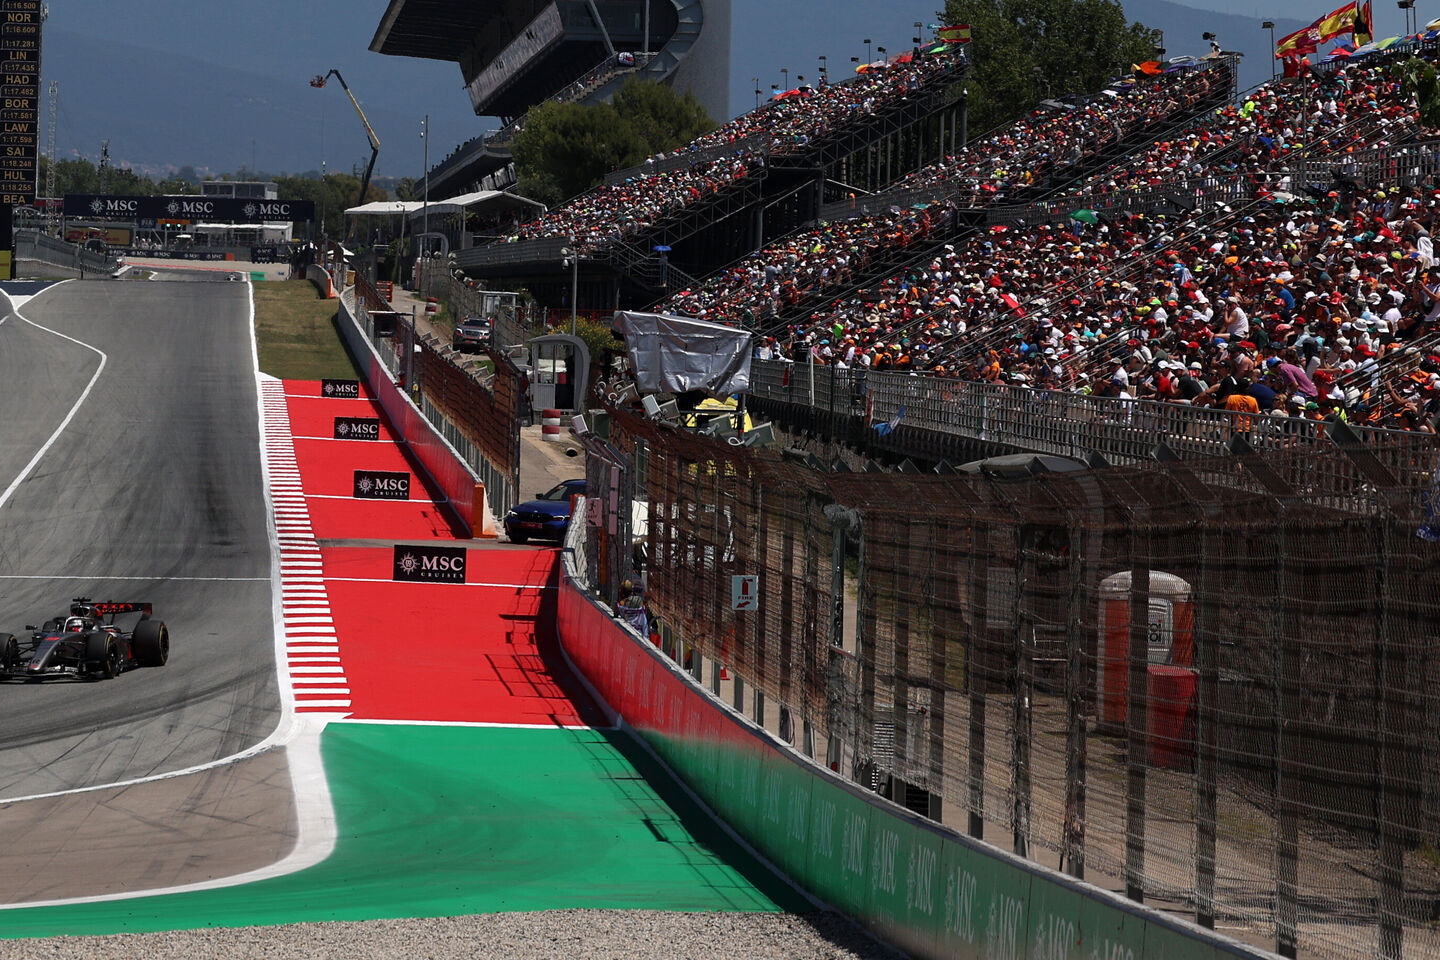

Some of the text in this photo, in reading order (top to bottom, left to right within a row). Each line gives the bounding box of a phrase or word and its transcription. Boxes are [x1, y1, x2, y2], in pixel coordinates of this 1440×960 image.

[8, 13, 31, 22] NOR
[10, 51, 27, 60] LIN
[6, 75, 30, 84] HAD
[5, 99, 29, 108] BOR
[4, 123, 29, 132] LAW
[6, 147, 25, 156] SAI
[4, 171, 26, 180] HUL
[3, 195, 26, 204] BEA
[106, 200, 138, 210] MSC
[182, 201, 214, 213] MSC
[260, 204, 290, 215] MSC
[336, 384, 358, 393] MSC
[351, 423, 378, 433] MSC
[375, 478, 408, 490] MSC
[421, 556, 464, 571] MSC
